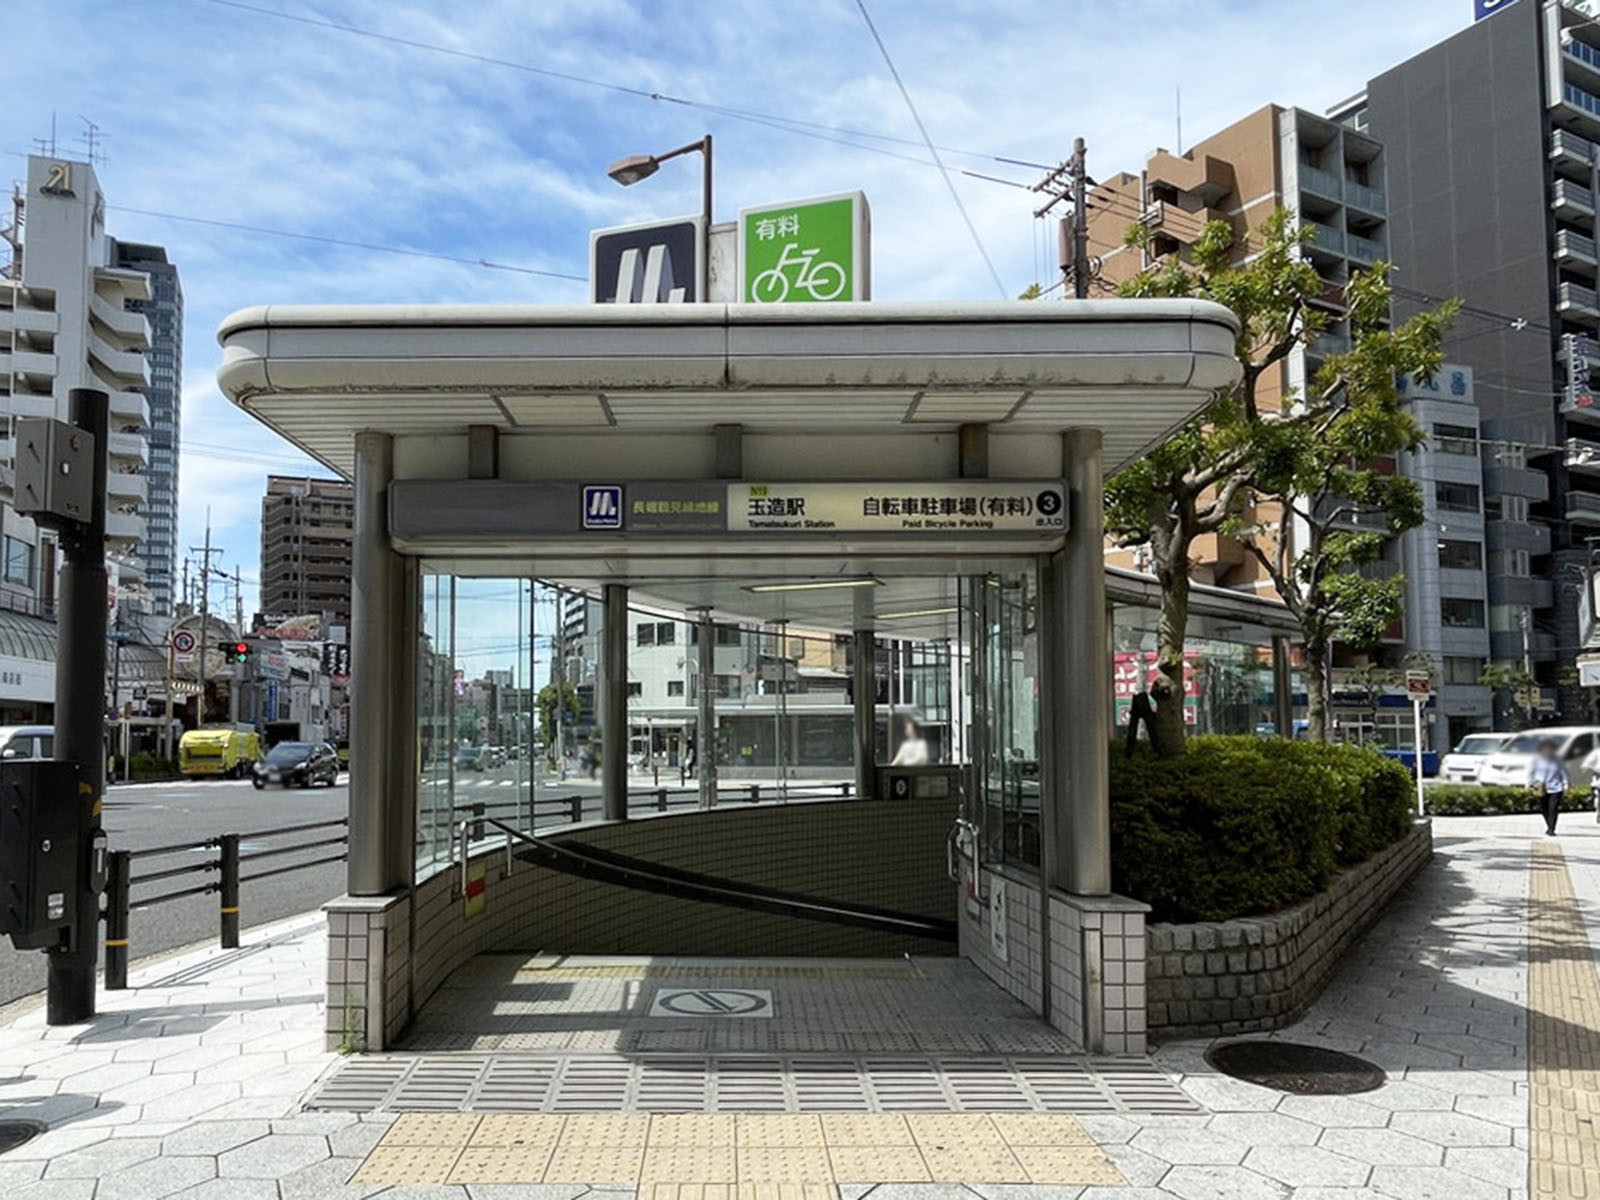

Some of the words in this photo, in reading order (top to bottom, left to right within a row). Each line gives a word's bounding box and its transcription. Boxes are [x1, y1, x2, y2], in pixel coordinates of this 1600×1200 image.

[755, 213, 800, 241] 有料
[748, 498, 805, 516] 玉造駅
[863, 496, 1033, 517] 自転車駐車場(有料)
[804, 520, 836, 529] Station
[902, 520, 922, 528] Paid
[924, 520, 957, 529] Bicycle
[959, 520, 994, 529] Parking
